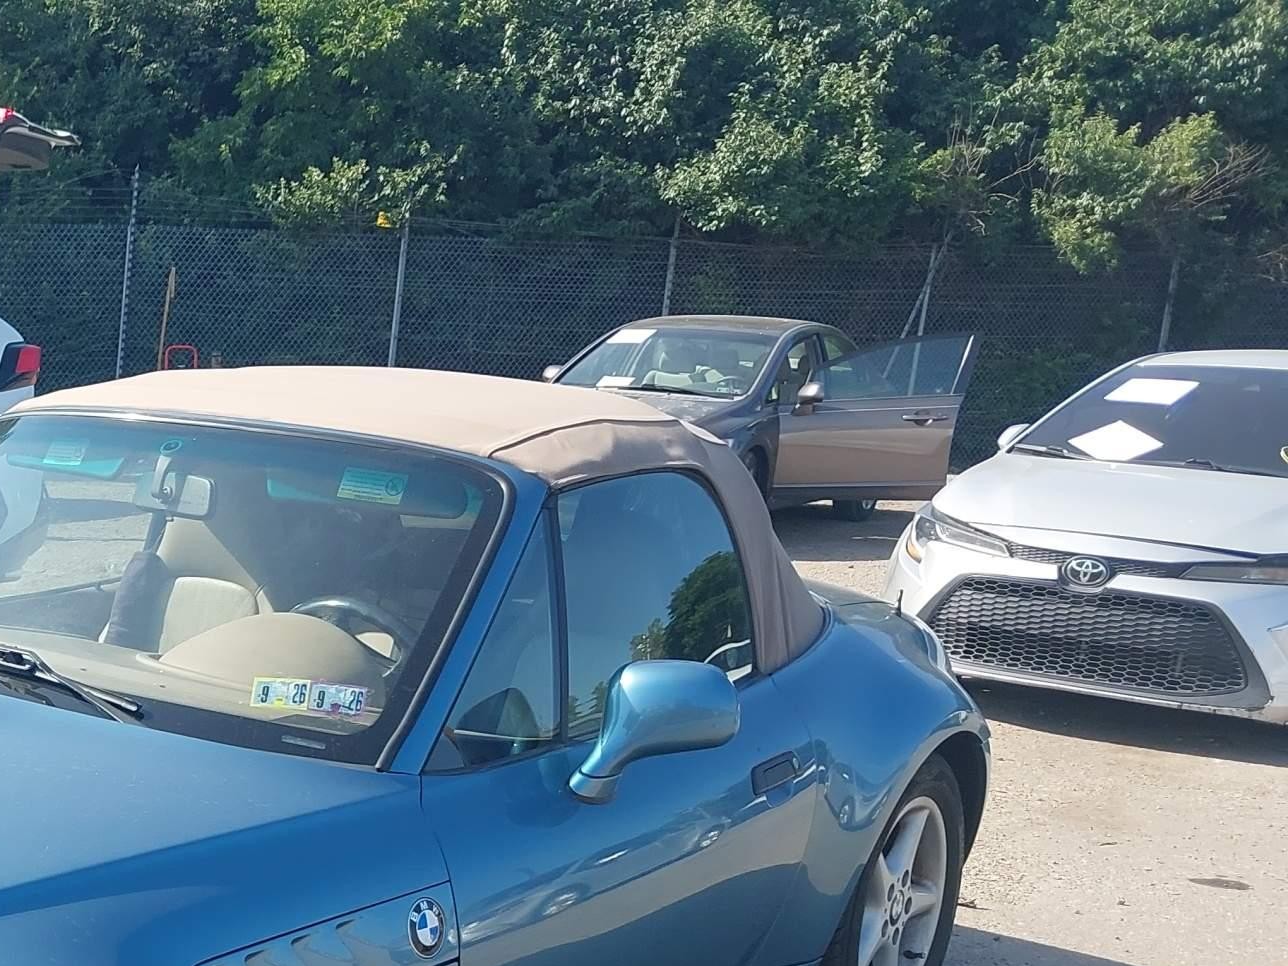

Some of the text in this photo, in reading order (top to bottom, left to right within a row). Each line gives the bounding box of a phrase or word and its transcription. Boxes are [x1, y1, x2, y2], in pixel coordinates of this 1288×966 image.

[260, 683, 308, 705] 9 26
[316, 690, 364, 712] 9 26
